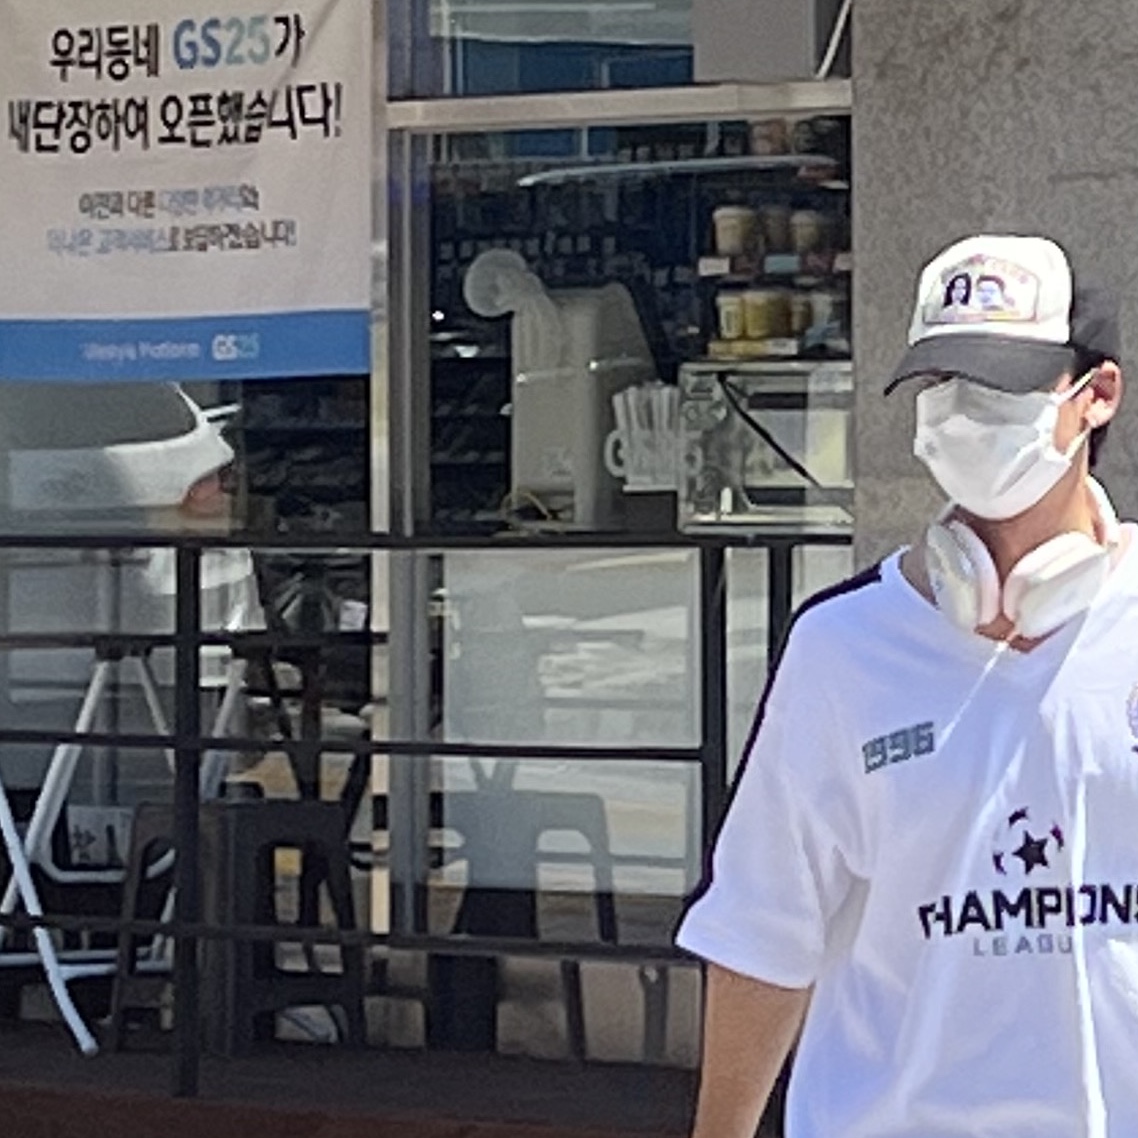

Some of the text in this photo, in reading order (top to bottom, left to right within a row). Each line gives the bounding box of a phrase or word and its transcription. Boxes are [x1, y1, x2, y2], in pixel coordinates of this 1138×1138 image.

[50, 14, 305, 82] 우리동네 GS25가
[158, 82, 342, 149] 오픈했습니다!
